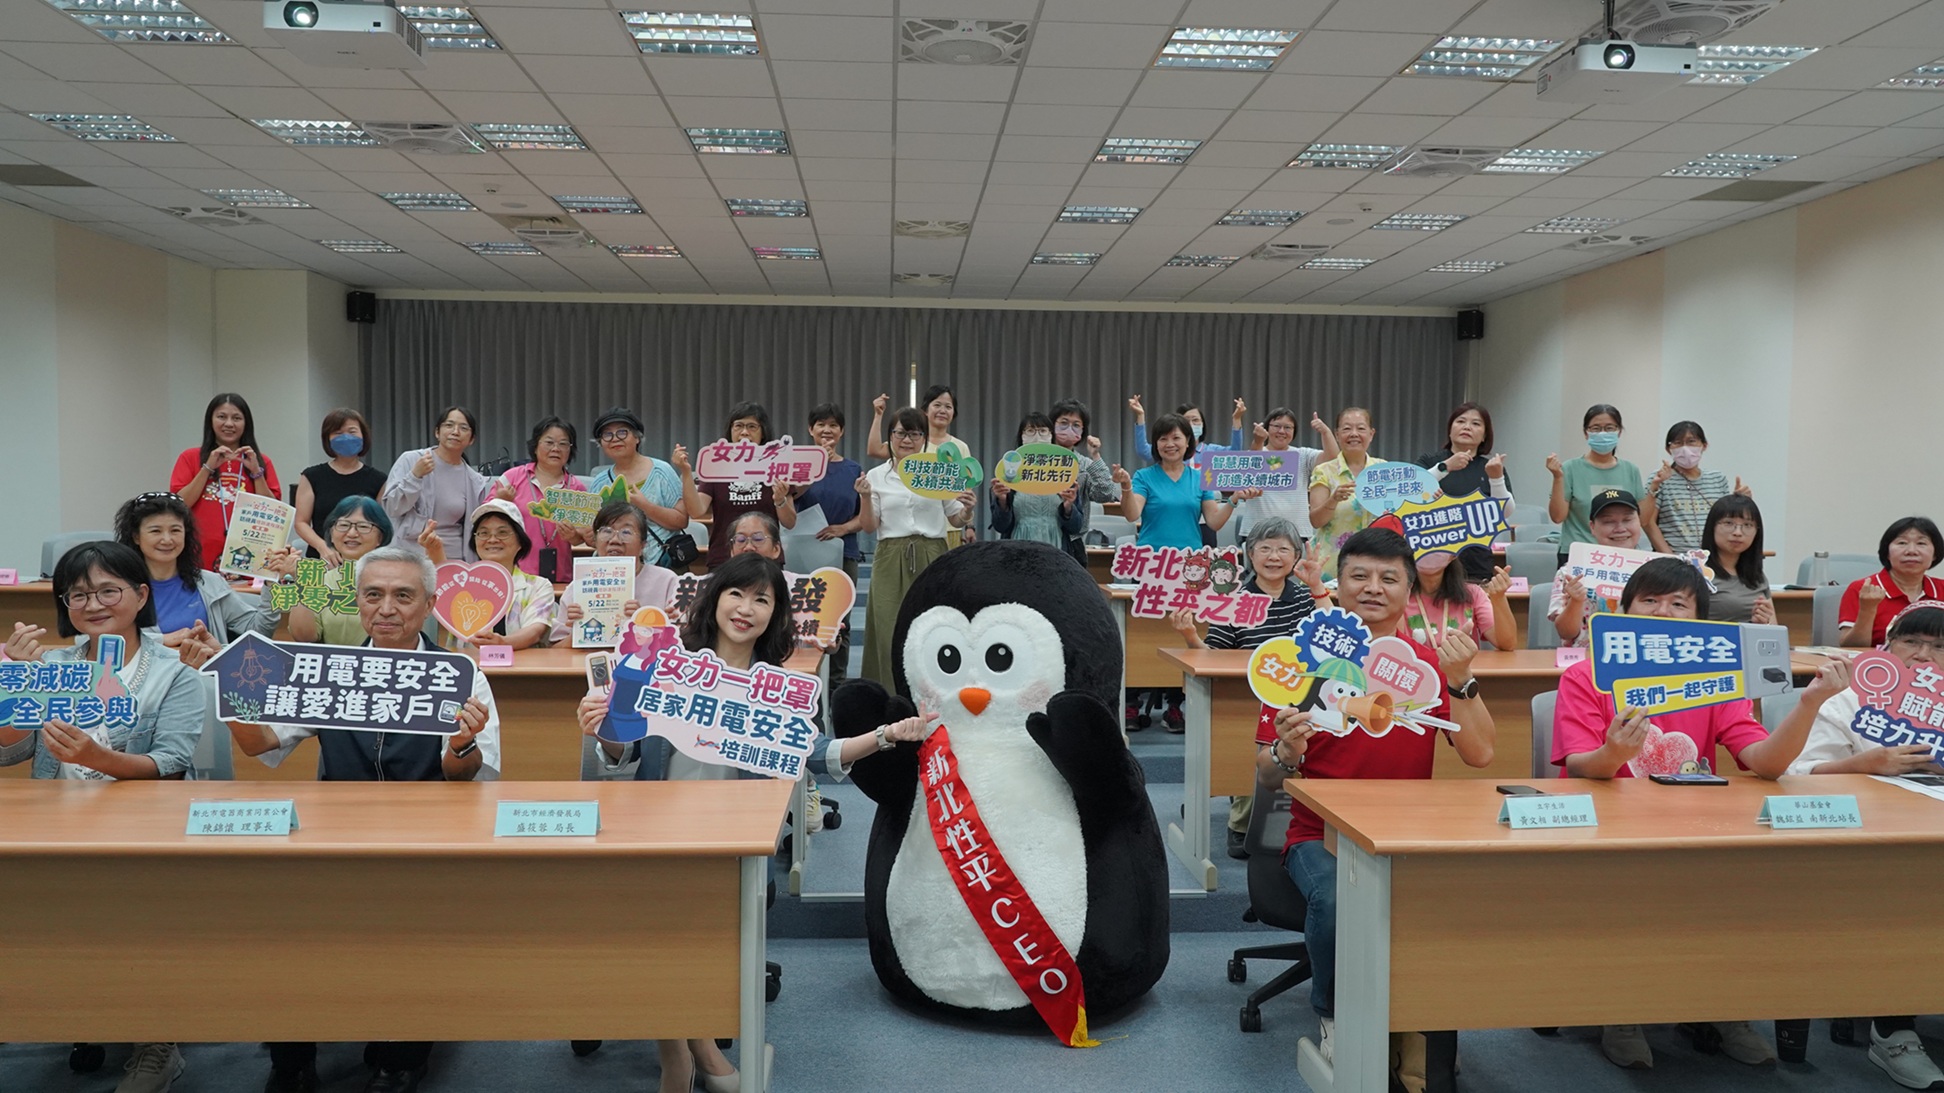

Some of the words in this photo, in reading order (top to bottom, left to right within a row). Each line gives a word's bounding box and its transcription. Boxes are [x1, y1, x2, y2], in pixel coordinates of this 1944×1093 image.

[711, 441, 755, 462] 女力
[1023, 453, 1074, 468] 淨零行動
[1212, 455, 1263, 470] 智慧用電
[744, 462, 812, 483] 一把罩
[904, 460, 960, 477] 科技節能
[1021, 469, 1072, 483] 新北先行
[1217, 472, 1294, 487] 打造永續城市
[1367, 467, 1416, 482] 節電行動
[729, 491, 762, 501] Banff
[1362, 481, 1424, 499] 全民一起來
[1404, 507, 1463, 530] 女力進階
[1408, 528, 1466, 549] Power
[1466, 500, 1500, 536] UP
[1114, 545, 1183, 581] 新北
[1590, 550, 1652, 568] 女力一
[1135, 583, 1271, 625] 性平之都
[1312, 623, 1359, 658] 技術
[1601, 631, 1738, 664] 用電安全
[289, 653, 461, 693] 用電要安全
[656, 648, 816, 711] 女力一把罩
[1259, 656, 1302, 688] 女力
[1373, 656, 1420, 692] 關懷
[264, 684, 434, 724] 讓愛進家戶
[1626, 676, 1736, 707] 我們一起守護
[13, 696, 135, 724] 全民參與
[637, 687, 813, 751] 居家用電安全
[719, 738, 801, 776] 培訓課程
[554, 822, 575, 833] 局長
[926, 746, 997, 892] 新北性平
[991, 897, 1068, 994] CEO
